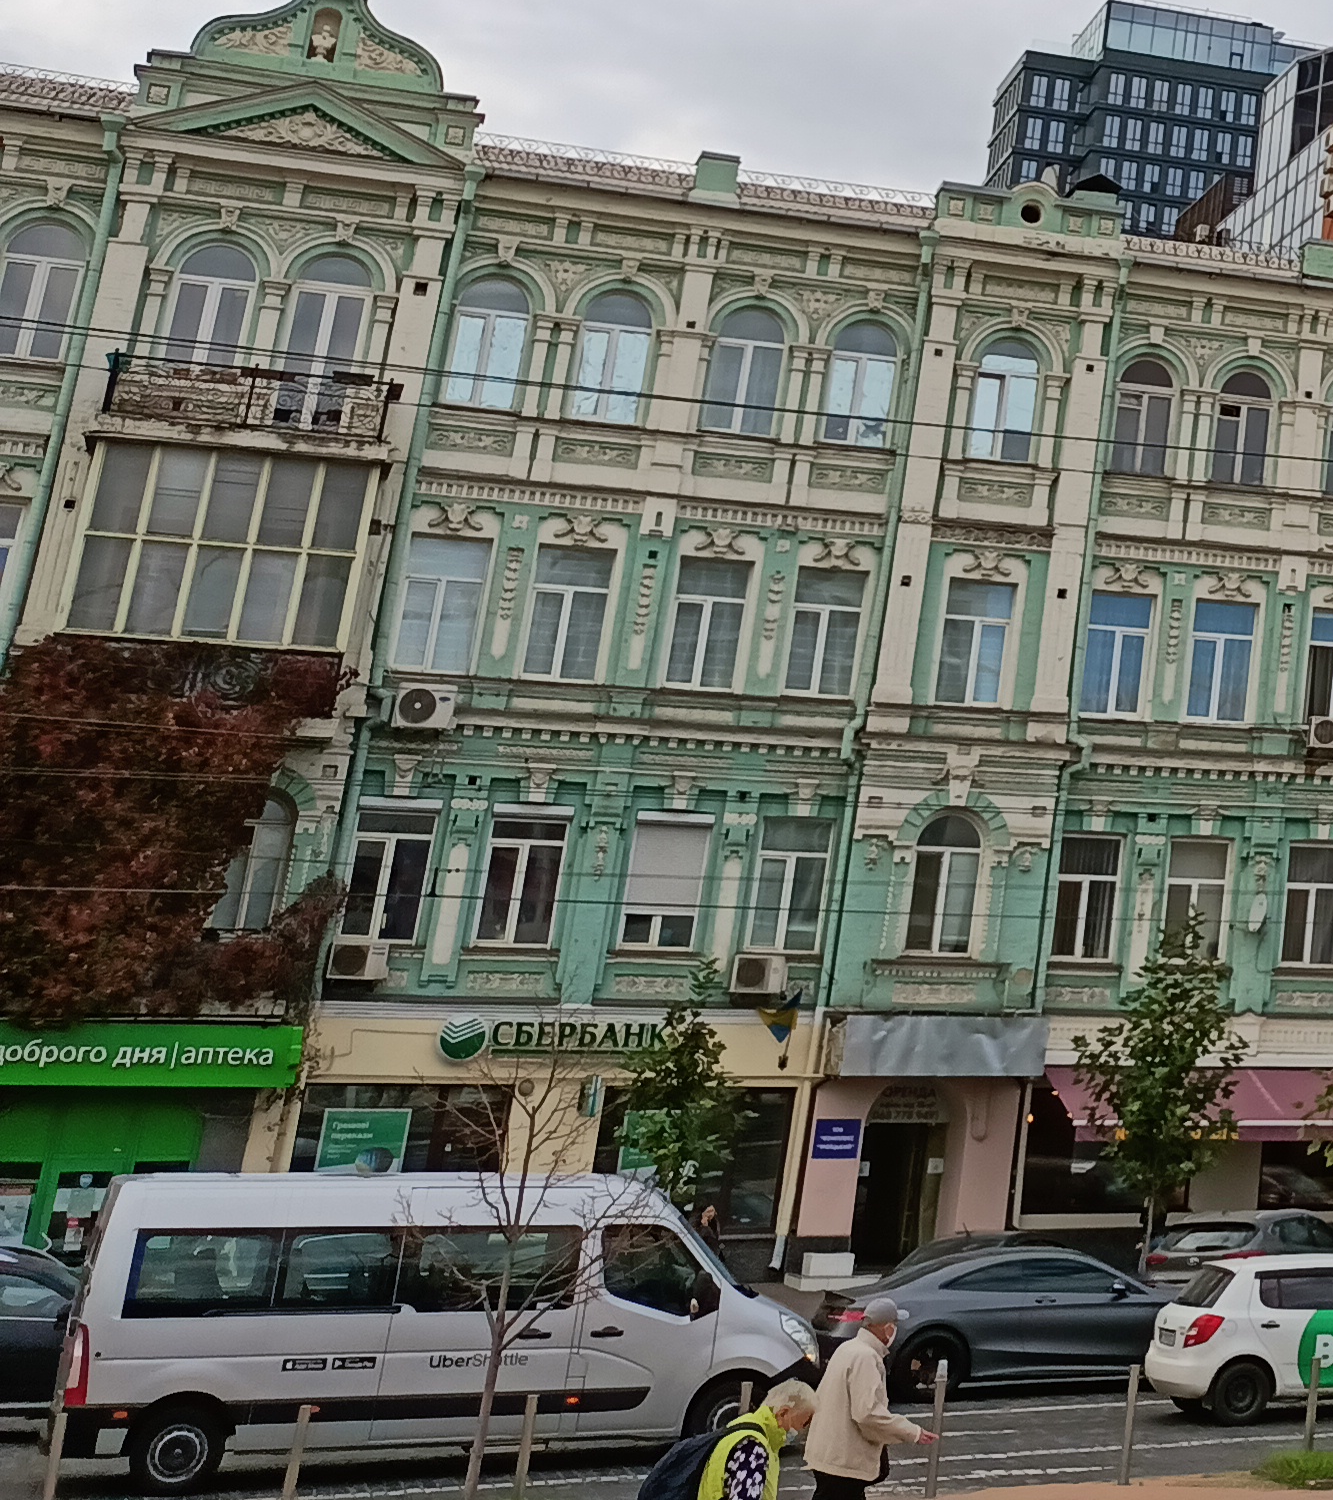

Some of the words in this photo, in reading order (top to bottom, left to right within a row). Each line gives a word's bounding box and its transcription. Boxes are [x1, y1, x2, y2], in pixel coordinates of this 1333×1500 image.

[492, 1020, 668, 1048] СБЕРБАНК
[112, 1046, 167, 1068] дня
[180, 1047, 275, 1066] аптека
[429, 1352, 529, 1369] UberShttle
